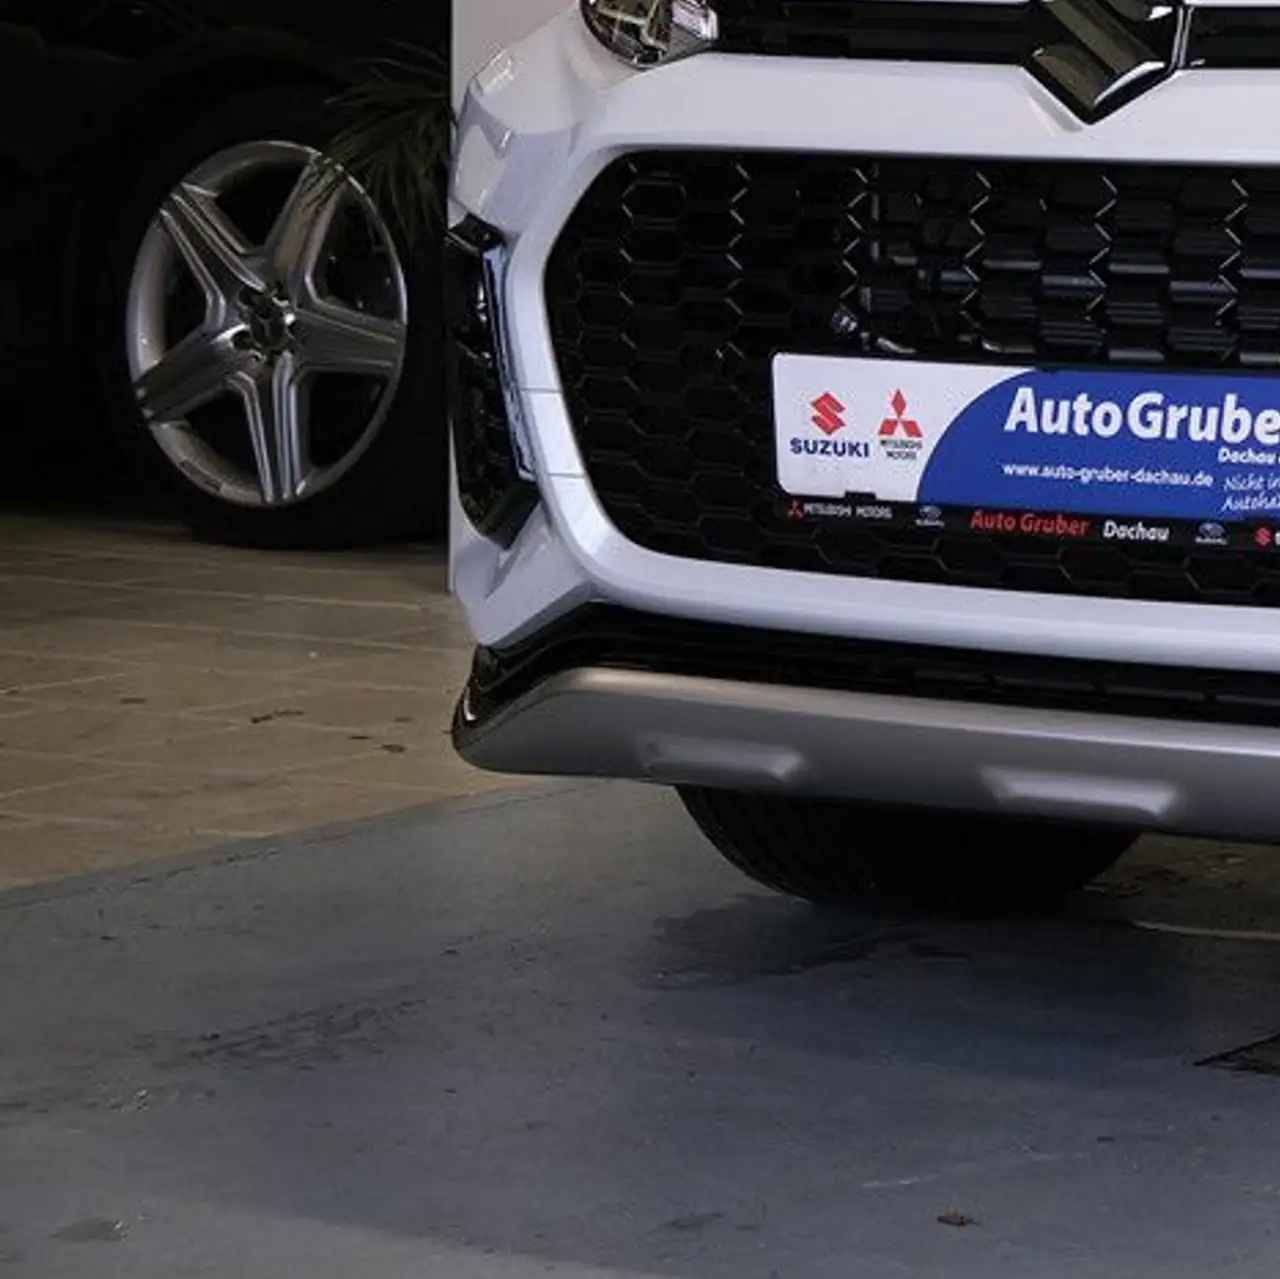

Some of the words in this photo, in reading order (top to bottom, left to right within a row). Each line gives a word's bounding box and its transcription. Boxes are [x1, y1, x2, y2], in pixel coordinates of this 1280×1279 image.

[790, 437, 869, 458] SUZUKI
[1218, 446, 1277, 464] Dachau
[1002, 464, 1213, 488] www.auto-gruber-dachau.de
[970, 509, 1016, 531] Auto
[1019, 513, 1089, 537] Gruber
[1103, 520, 1170, 542] Dachau
